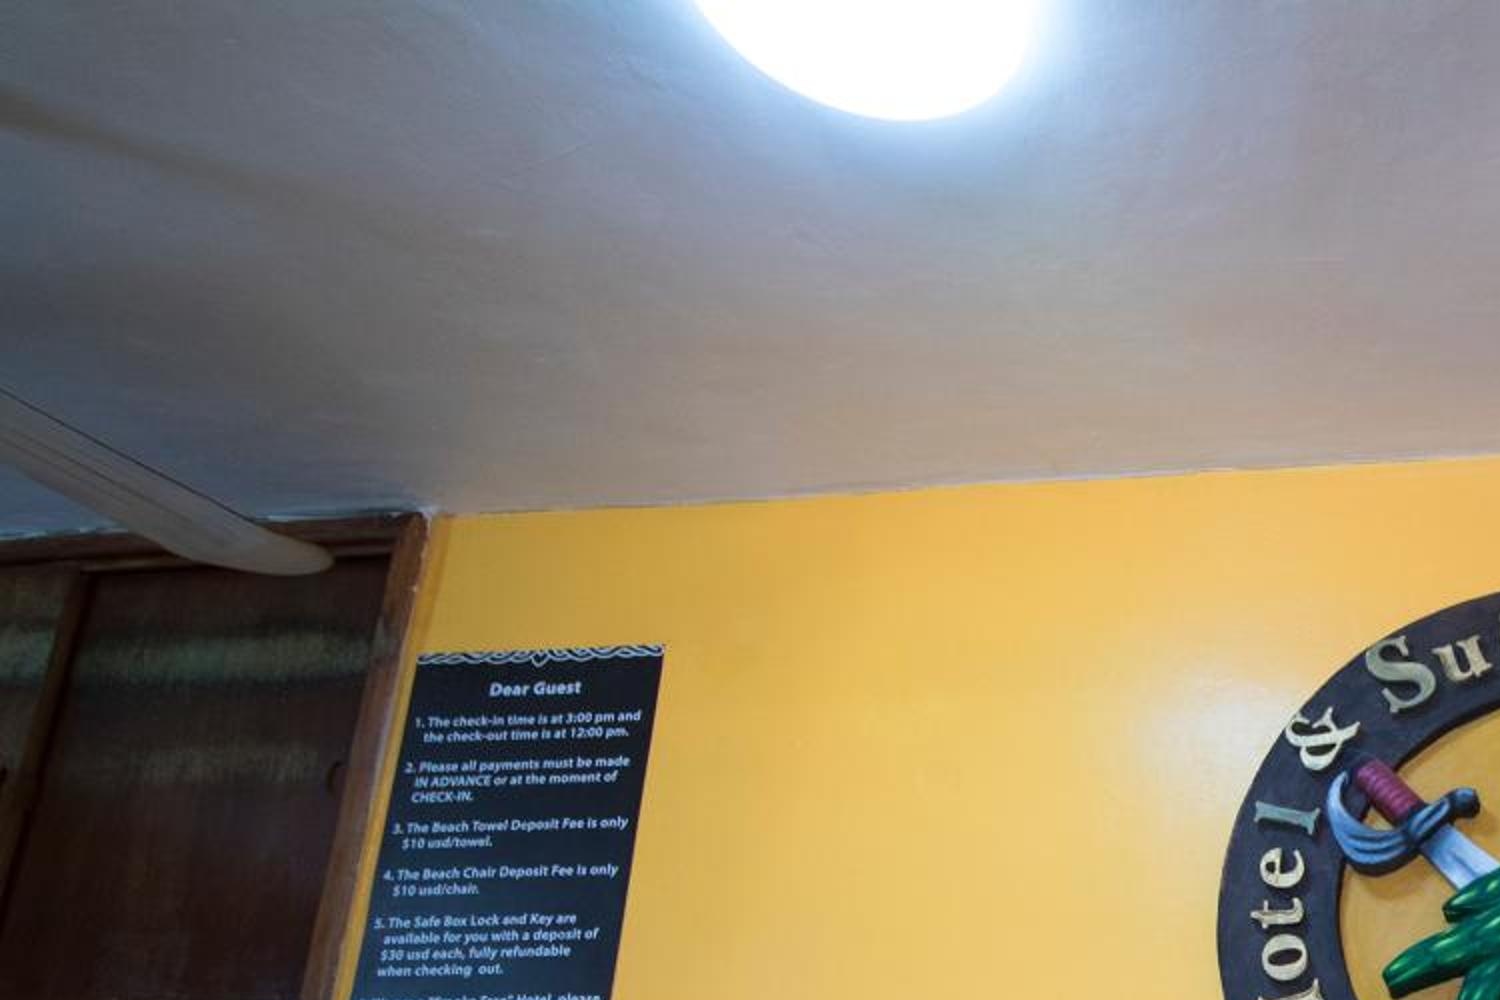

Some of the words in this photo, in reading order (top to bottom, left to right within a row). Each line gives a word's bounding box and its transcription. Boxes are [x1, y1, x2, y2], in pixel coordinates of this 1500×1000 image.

[489, 682, 530, 697] Dear
[532, 681, 582, 696] Guest
[427, 716, 451, 728] The
[452, 714, 505, 727] check-in
[506, 714, 536, 726] time
[537, 713, 549, 725] is
[549, 713, 564, 725] at
[565, 711, 593, 724] 3:00
[593, 713, 616, 725] pm
[617, 709, 642, 722] and
[423, 731, 445, 743] the
[445, 729, 509, 742] check-out
[510, 729, 539, 740] time
[540, 728, 552, 739] is
[553, 728, 567, 739] at
[571, 725, 604, 738] 12:00
[604, 727, 629, 740] pm.
[1285, 706, 1361, 772] &
[410, 790, 473, 803] CHECK-IN.
[401, 837, 426, 851] $10
[383, 869, 395, 881] 4.
[397, 869, 421, 881] The
[421, 867, 461, 880] Beach
[462, 866, 497, 879] Chair
[498, 865, 549, 880] Deposit
[550, 864, 574, 877] Fee
[575, 864, 588, 876] is
[589, 863, 619, 878] only
[392, 884, 417, 897] $10
[417, 882, 479, 896] usd/chair.
[376, 965, 412, 977] when
[413, 963, 473, 978] checking
[477, 963, 504, 975] out.
